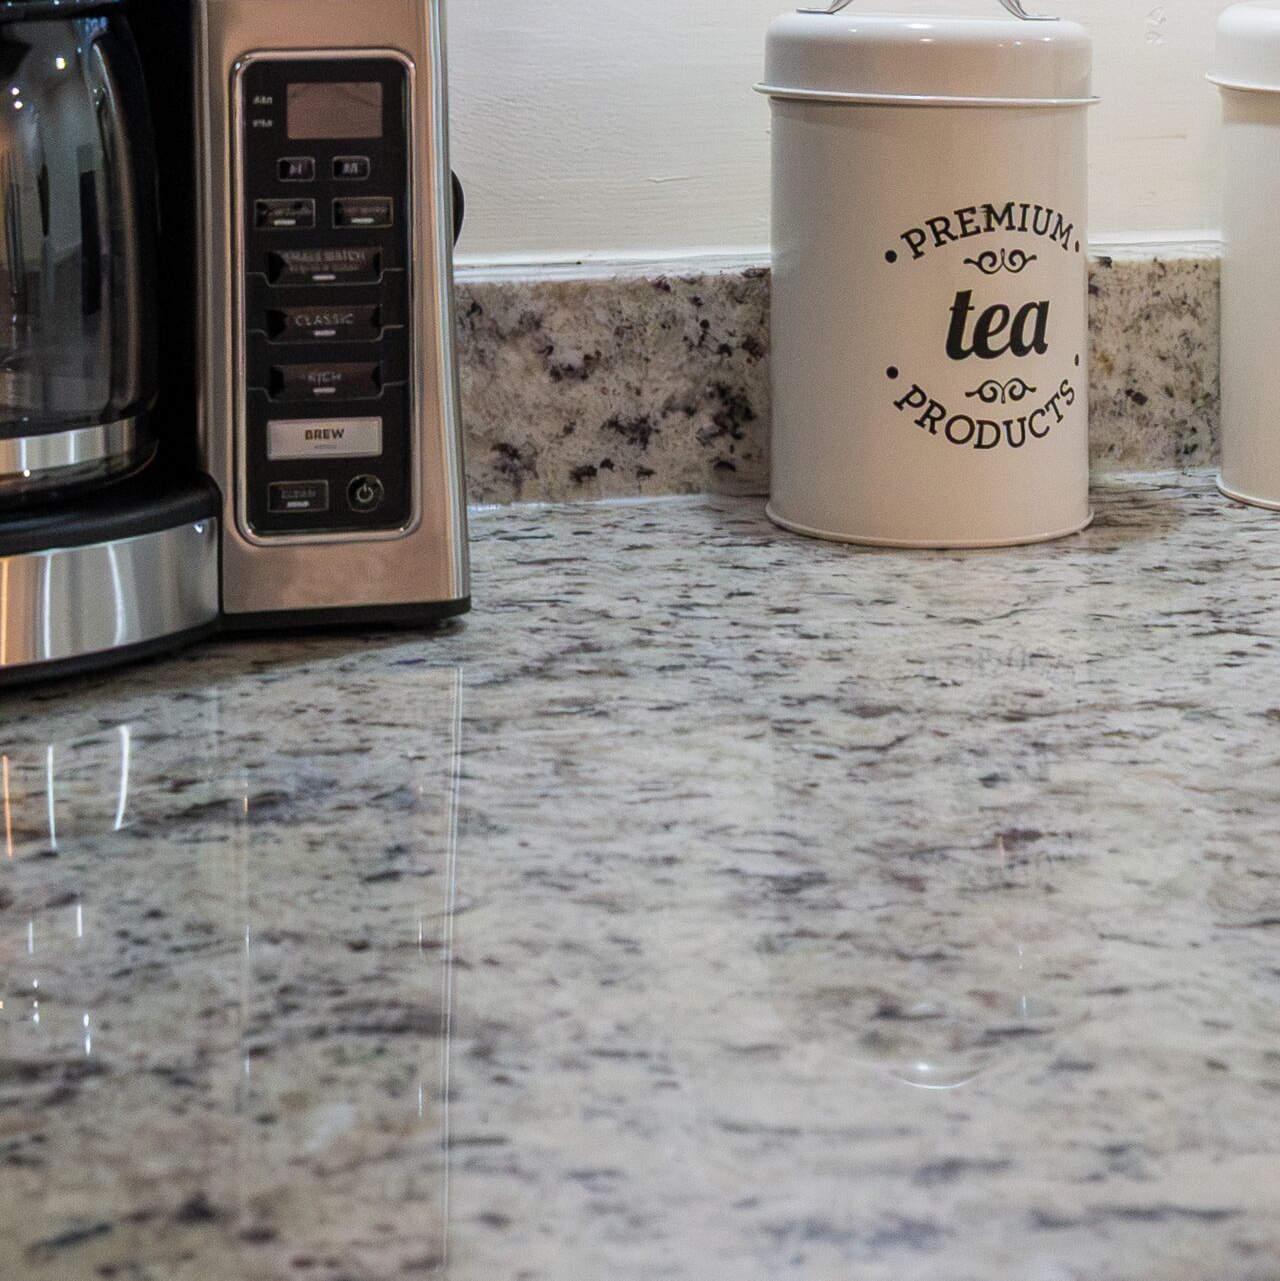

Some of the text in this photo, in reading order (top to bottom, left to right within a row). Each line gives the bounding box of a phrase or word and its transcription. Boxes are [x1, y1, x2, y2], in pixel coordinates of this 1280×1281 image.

[900, 201, 1073, 260] PREMIUM
[295, 313, 355, 326] CLASSIC
[945, 289, 1050, 361] tea
[305, 427, 345, 441] BREW
[893, 379, 1075, 450] PRODUCTS
